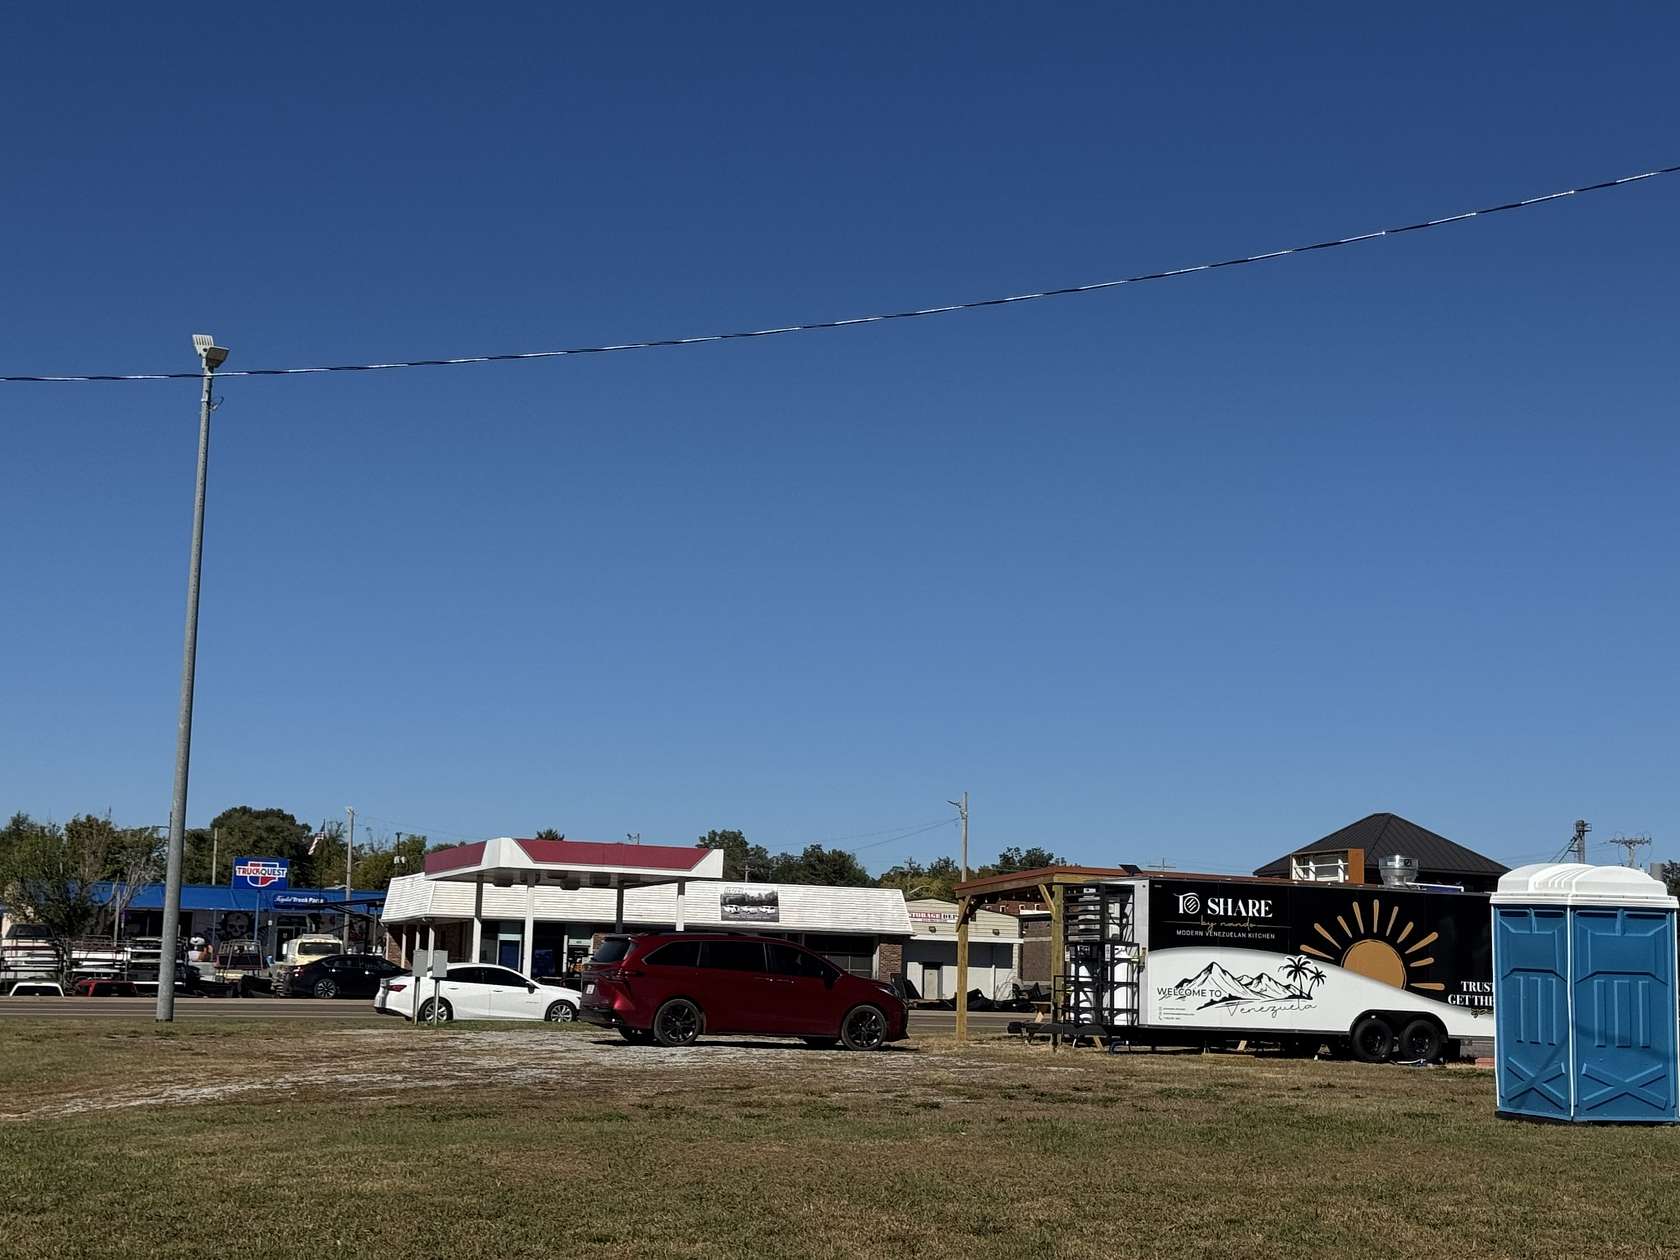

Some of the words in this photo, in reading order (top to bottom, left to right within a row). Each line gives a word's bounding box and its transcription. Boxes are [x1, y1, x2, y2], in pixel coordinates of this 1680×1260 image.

[1207, 897, 1273, 918] SHARE
[1200, 914, 1217, 932] by
[1205, 930, 1246, 938] VENEZUELAN
[1157, 987, 1207, 998] WELCOME
[1209, 989, 1222, 998] TO
[1447, 993, 1471, 1006] GET
[1227, 999, 1317, 1018] Venezuela
